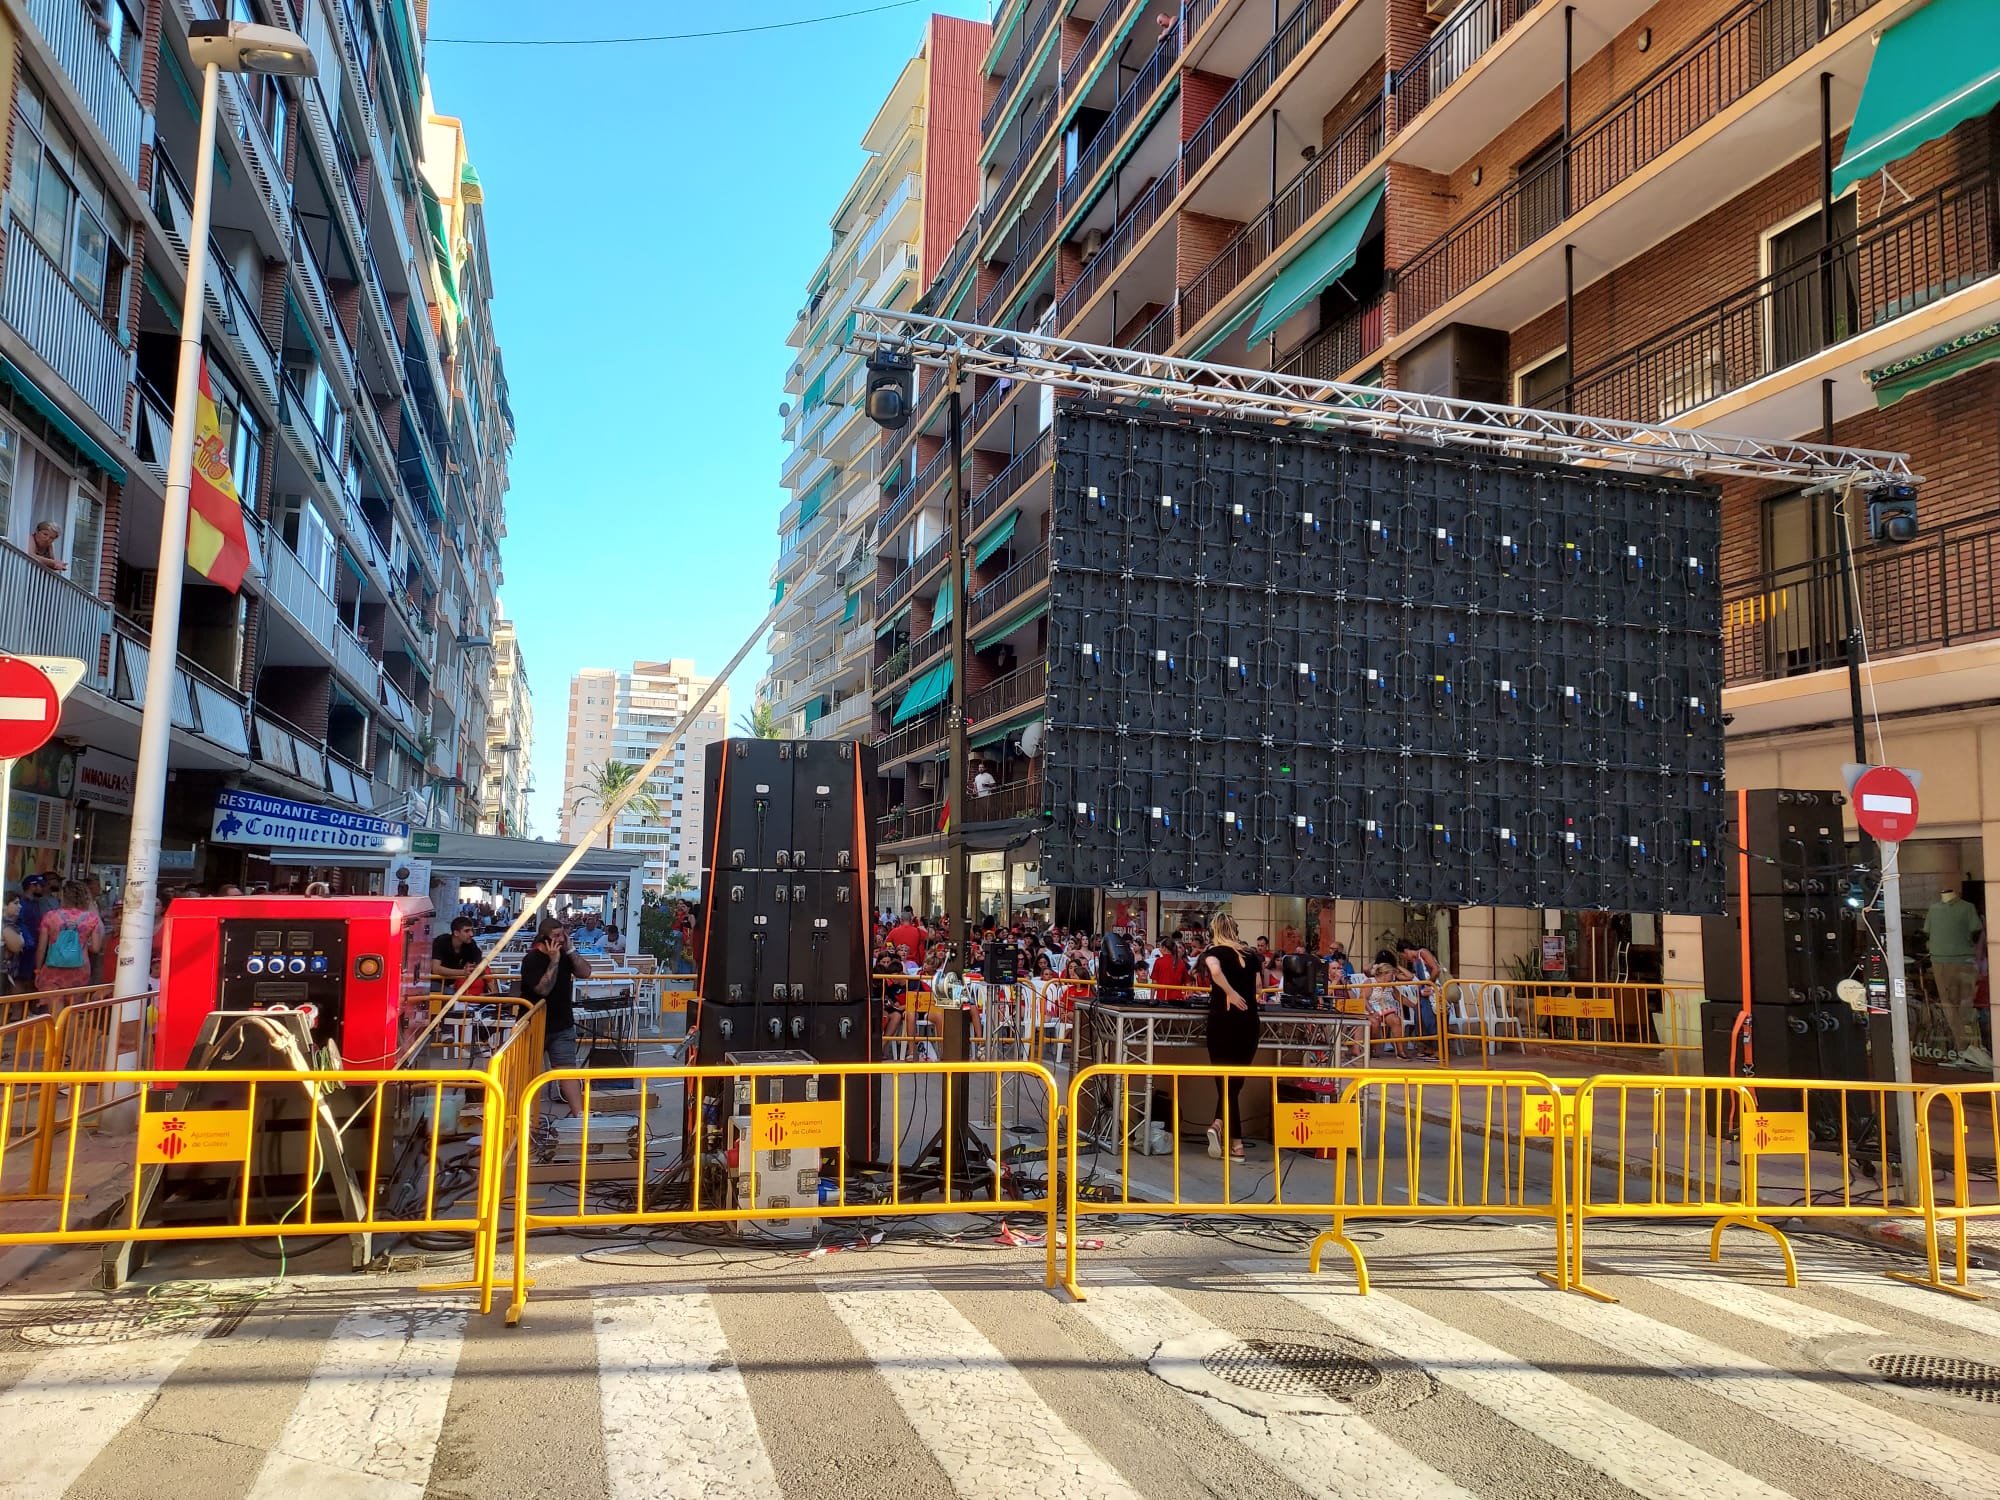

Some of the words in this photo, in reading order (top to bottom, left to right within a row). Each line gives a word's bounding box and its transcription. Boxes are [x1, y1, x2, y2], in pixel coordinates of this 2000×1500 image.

[81, 766, 121, 791] INMOALFA
[219, 793, 318, 821] RESTAURANTE
[329, 813, 403, 836] CAFETERIA
[245, 817, 370, 848] Conqueridor
